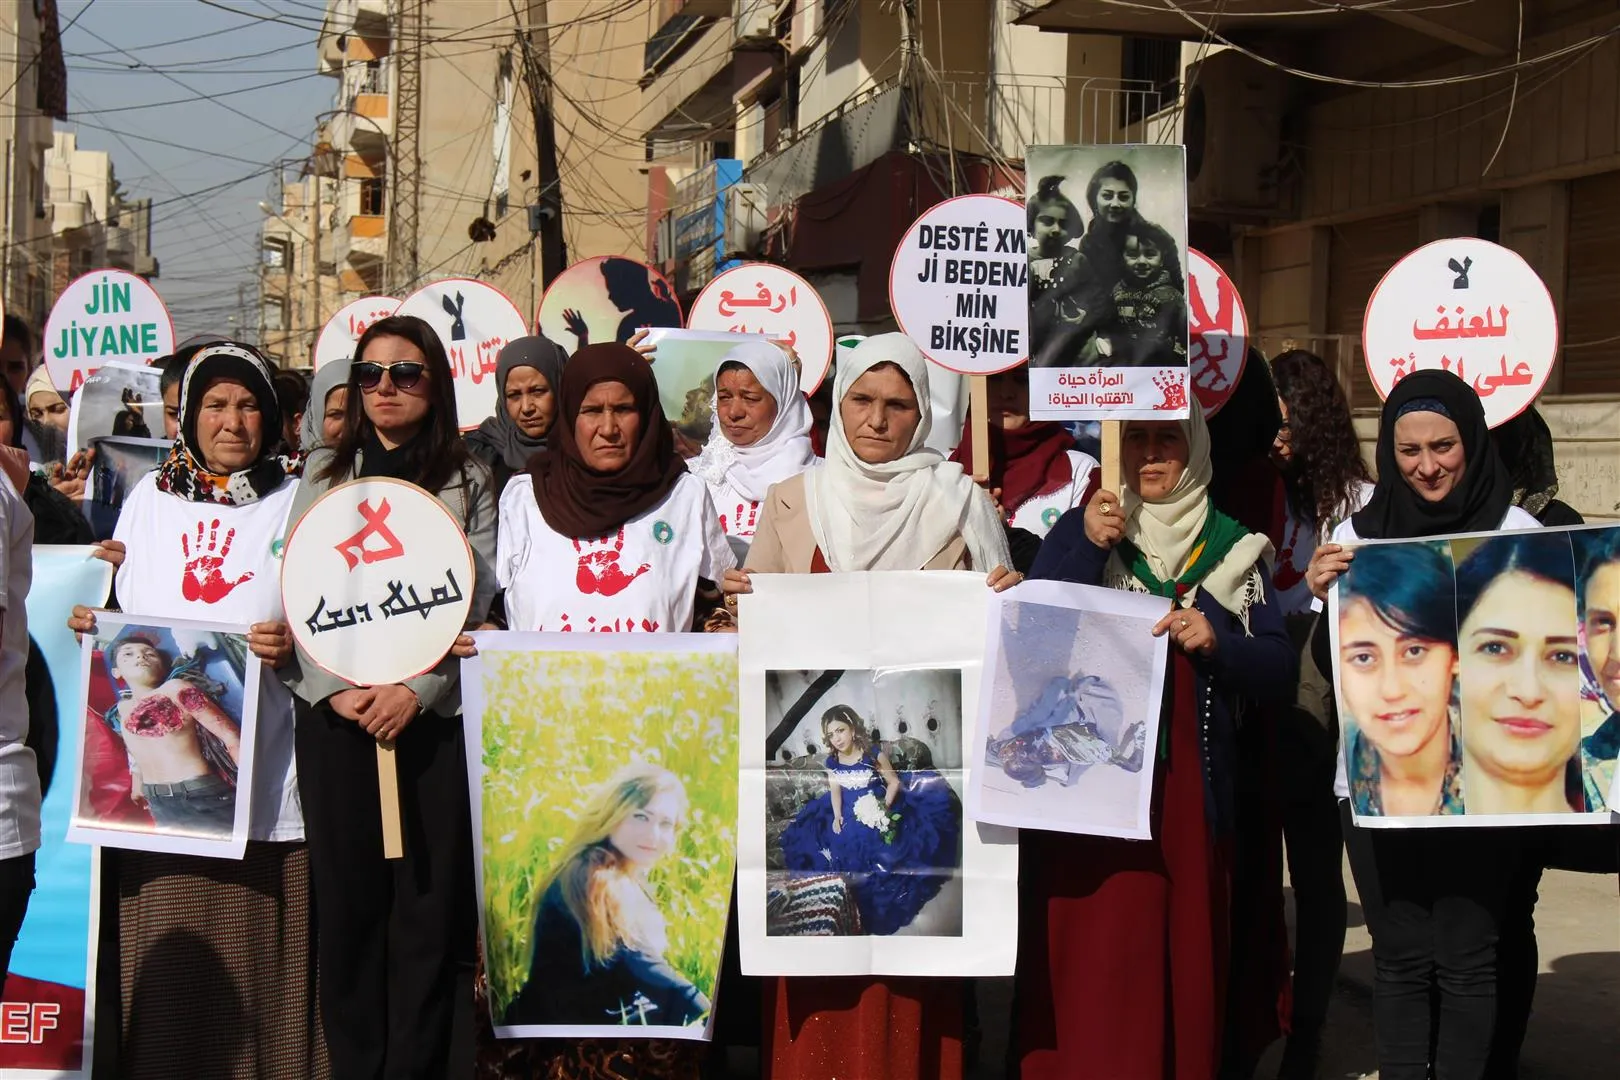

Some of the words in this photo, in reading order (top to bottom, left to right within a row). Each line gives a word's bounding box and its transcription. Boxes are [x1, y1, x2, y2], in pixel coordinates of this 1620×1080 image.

[918, 221, 989, 252] DESTÊ
[994, 228, 1026, 254] XW
[1448, 255, 1473, 290] لا
[84, 276, 131, 315] JİN
[718, 281, 797, 318] ارفع
[956, 288, 997, 319] MİN
[442, 290, 466, 341] لا
[1412, 303, 1510, 341] للعنف
[53, 320, 158, 359] JİYANE
[930, 319, 1020, 359] BİKŞÎNE
[1058, 373, 1086, 389] حياة
[1088, 368, 1124, 388] المرأة
[1473, 353, 1533, 398] على
